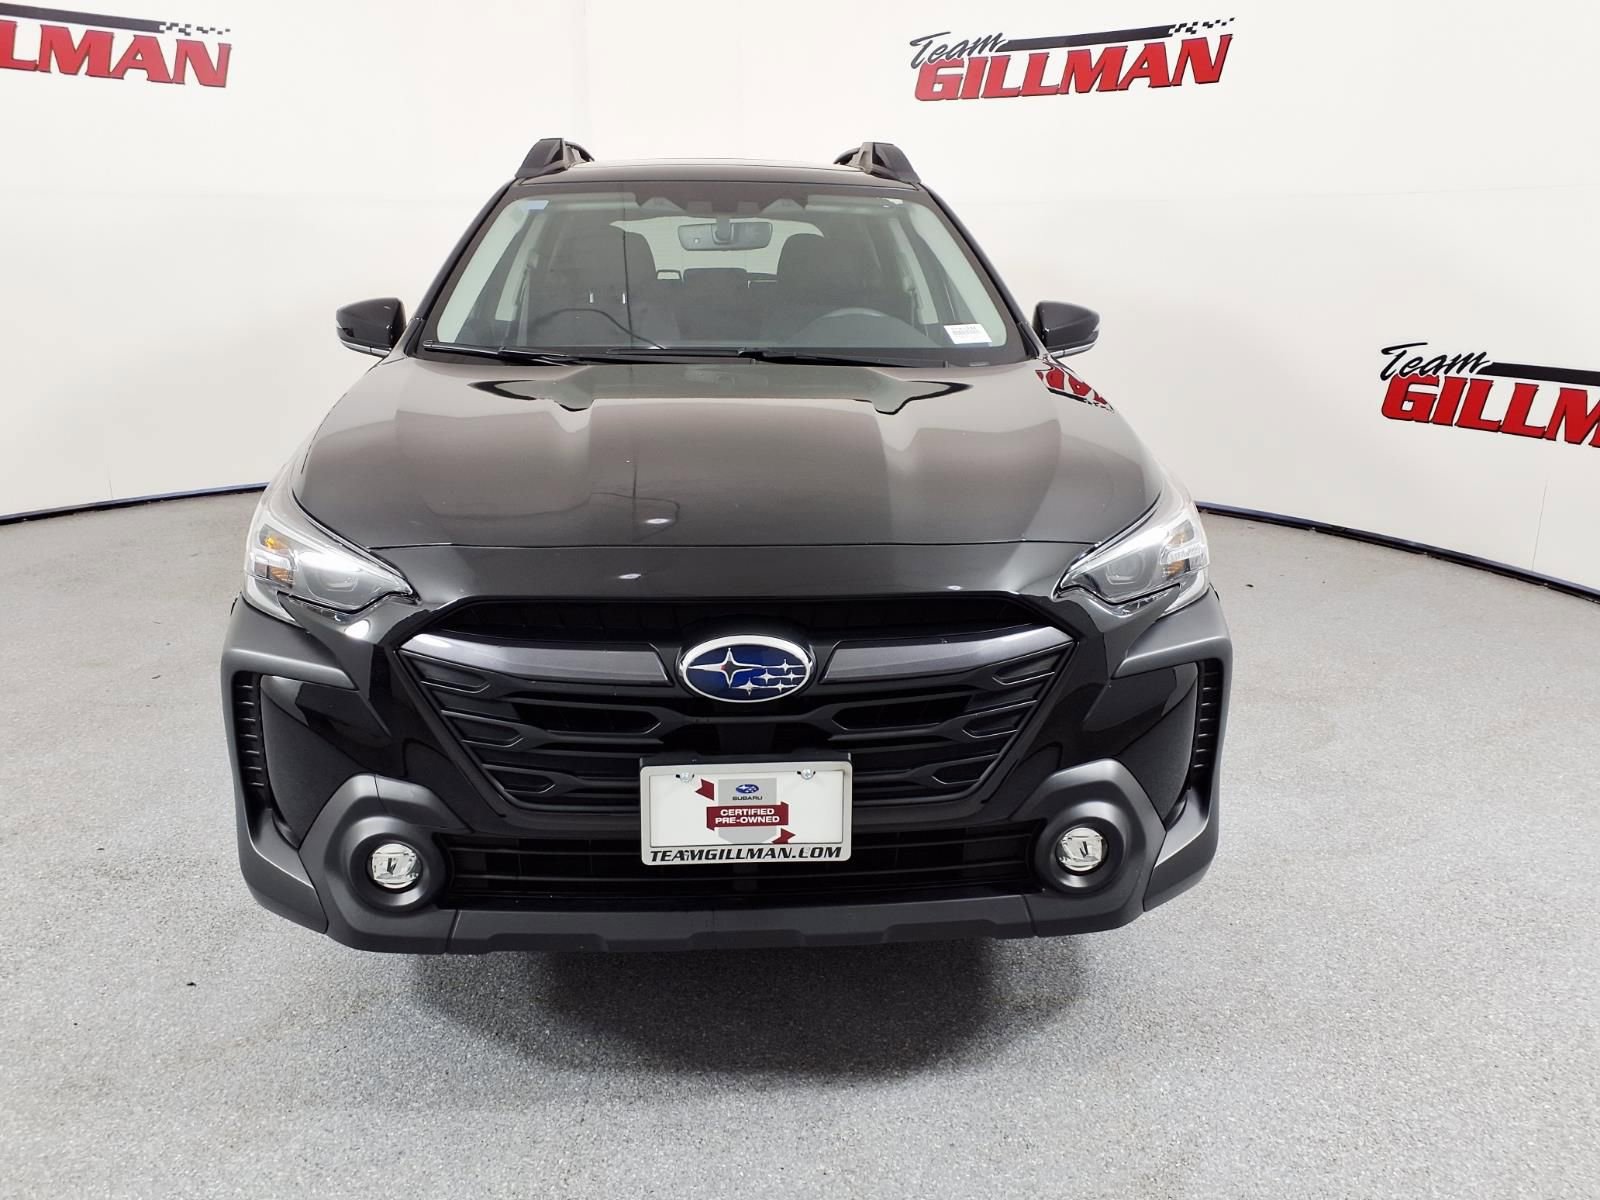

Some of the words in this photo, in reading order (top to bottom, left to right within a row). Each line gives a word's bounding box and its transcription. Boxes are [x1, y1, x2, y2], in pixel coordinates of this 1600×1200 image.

[910, 31, 1007, 69] Team
[915, 34, 1233, 101] GILLMAN
[1380, 342, 1490, 381] Team
[715, 815, 780, 824] PRE-OWNED
[720, 808, 775, 816] CERTIFIED
[650, 847, 842, 862] TEAMGILLMAN.COM
